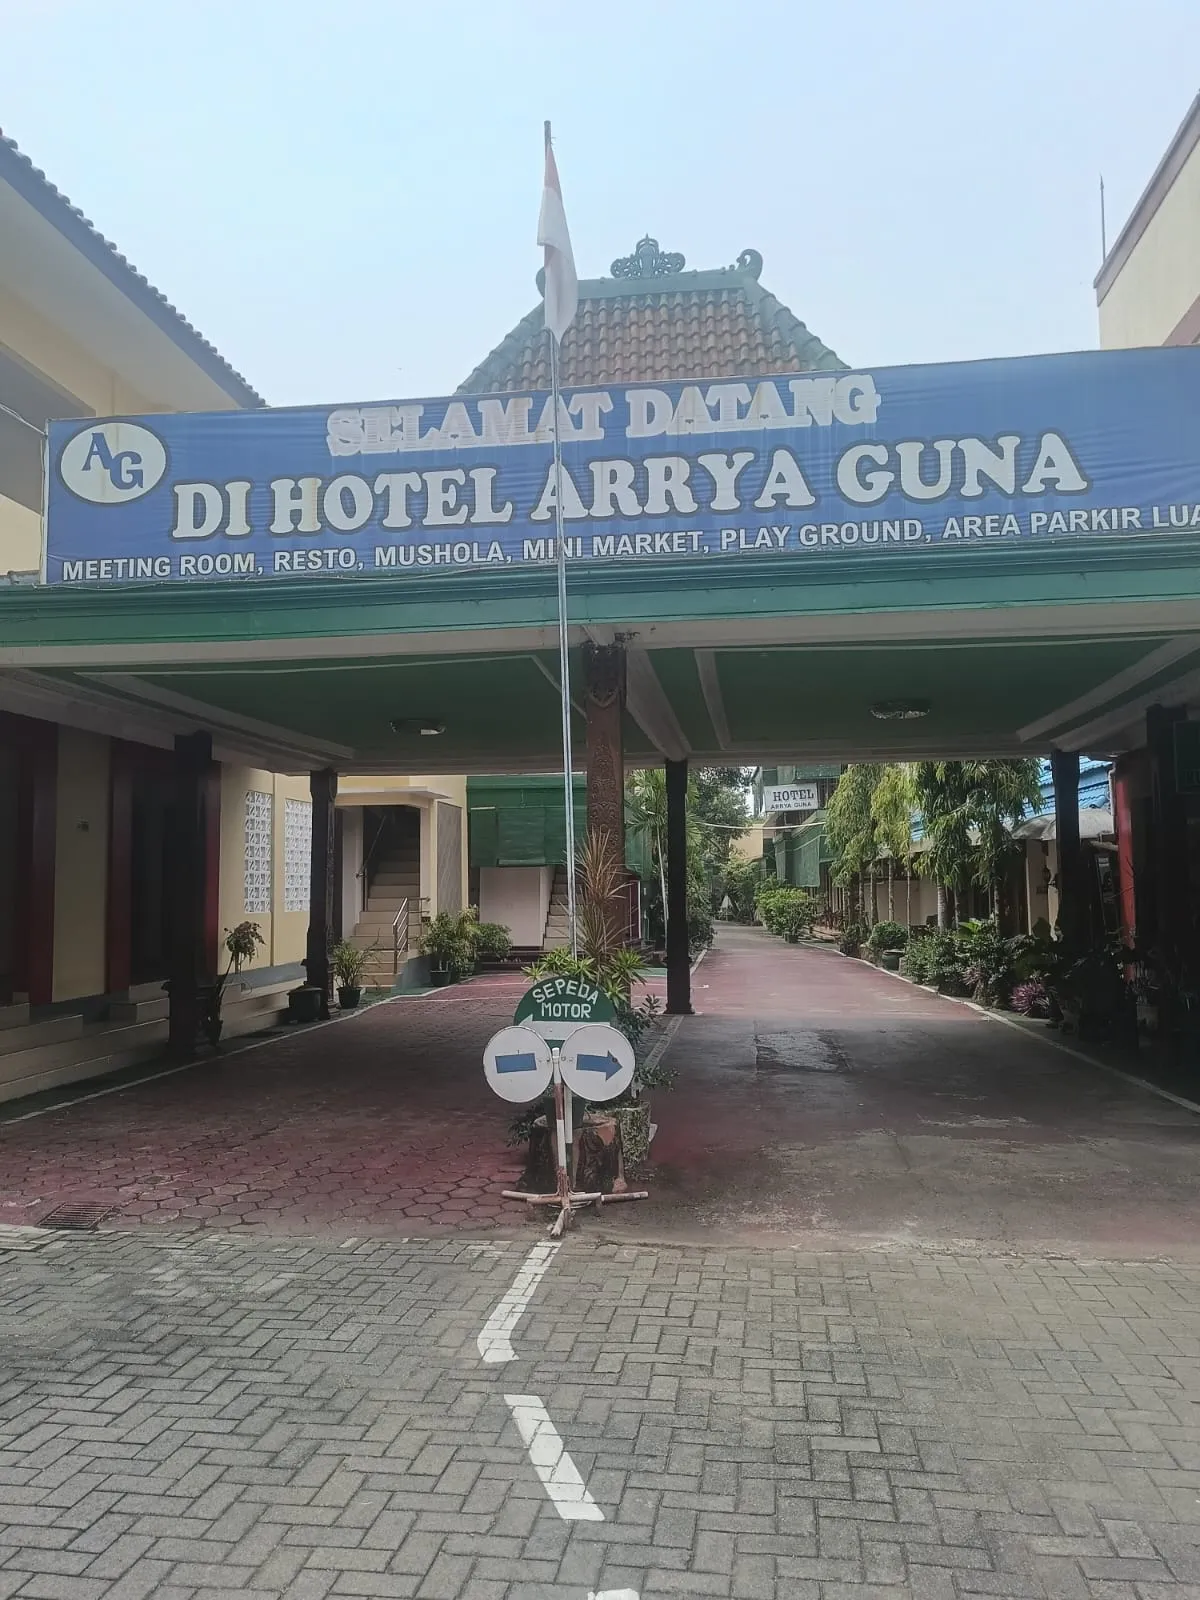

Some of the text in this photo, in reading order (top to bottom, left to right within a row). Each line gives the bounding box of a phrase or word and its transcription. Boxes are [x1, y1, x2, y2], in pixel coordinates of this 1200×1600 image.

[327, 375, 881, 456] SELAMAT DATANG
[82, 432, 143, 490] AG
[172, 433, 1087, 538] DI HOTEL ARRYA GUNA
[63, 557, 171, 581] MEETING
[180, 551, 263, 576] ROOM,
[274, 548, 364, 572] RESTO,
[375, 541, 512, 565] MUSHOLA,
[523, 537, 583, 560] MINI
[592, 530, 709, 557] MARKET,
[721, 526, 790, 549] PLAY
[800, 518, 931, 545] GROUND,
[942, 514, 1021, 538] AREA
[1030, 507, 1143, 534] PARKIR
[773, 789, 814, 802] HOTEL
[532, 978, 599, 1005] SEPEDA
[541, 1002, 592, 1018] MOTOR
